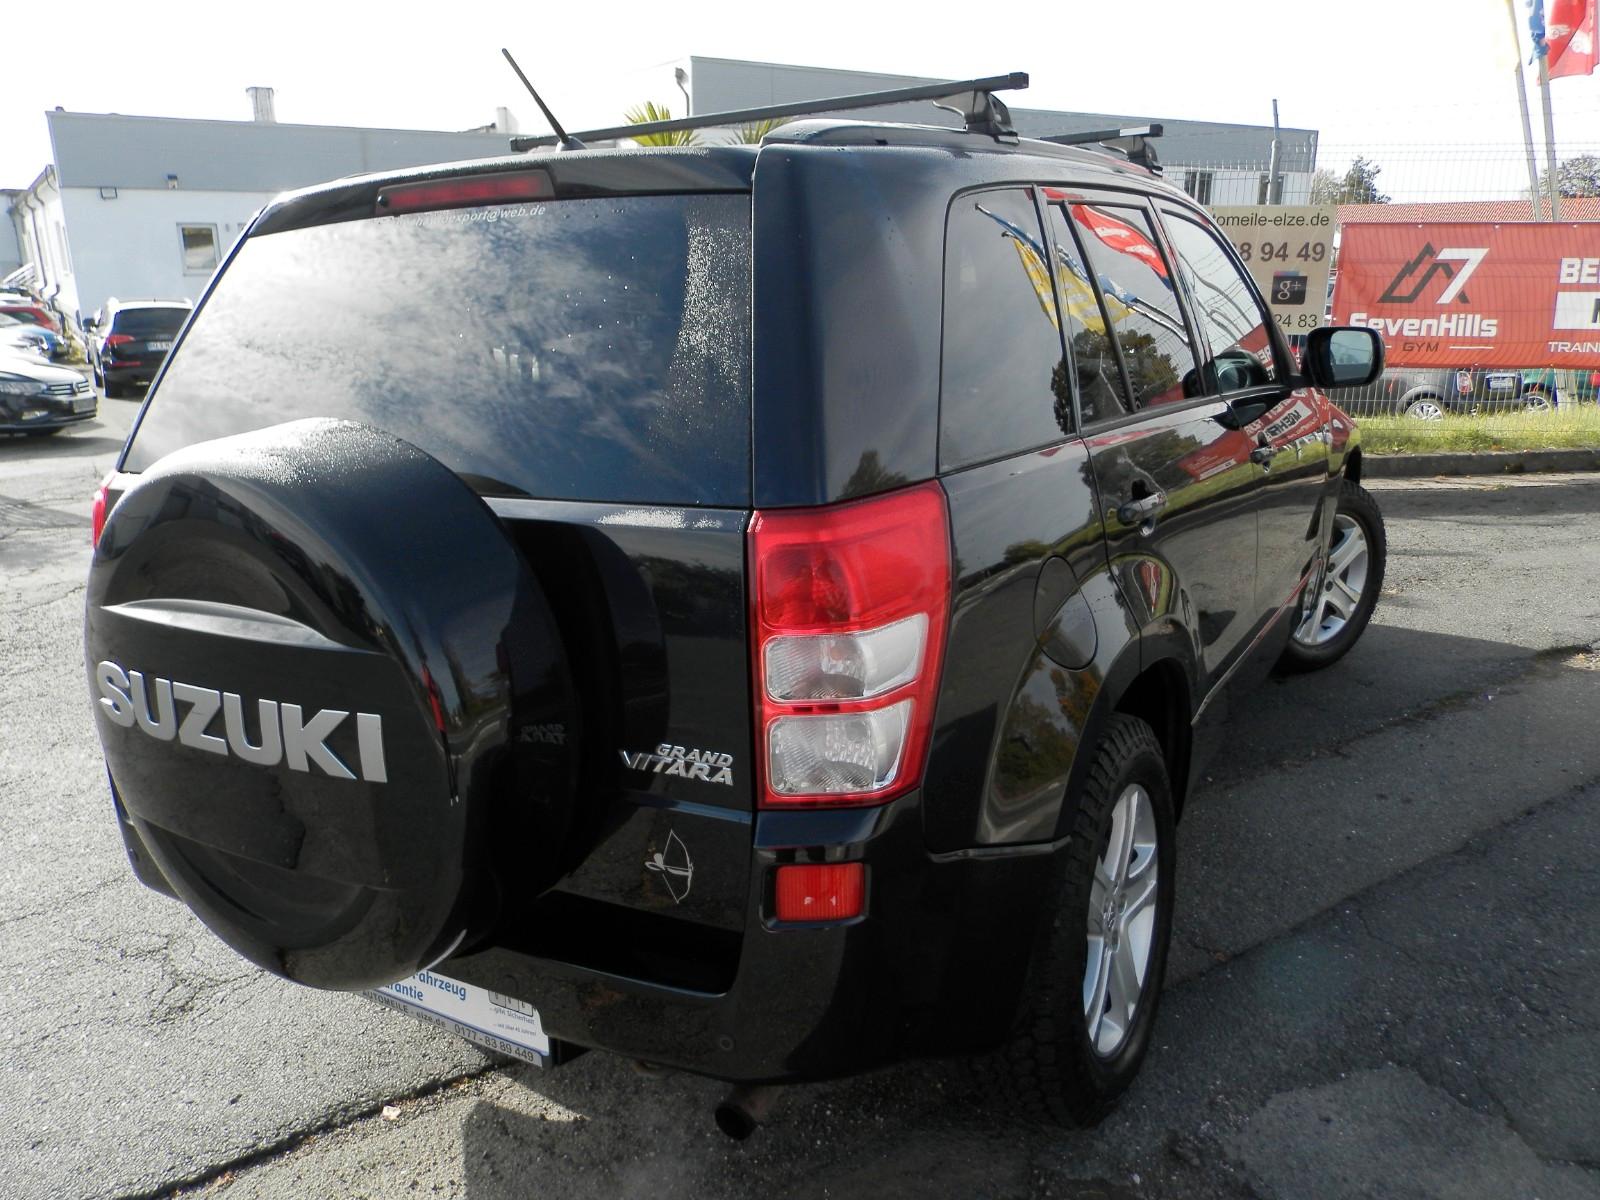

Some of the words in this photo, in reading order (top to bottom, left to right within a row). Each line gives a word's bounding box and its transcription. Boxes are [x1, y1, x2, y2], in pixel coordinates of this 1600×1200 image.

[1260, 242, 1289, 262] 94
[1296, 242, 1326, 262] 49
[1435, 247, 1490, 304] 7
[1297, 313, 1318, 328] 83
[1402, 341, 1440, 353] GYM
[96, 660, 389, 784] SUZUKI
[617, 749, 734, 786] VITARA
[656, 743, 734, 768] GRAND
[454, 1023, 477, 1041] 0177
[485, 1035, 498, 1049] 83
[514, 1046, 535, 1063] 449
